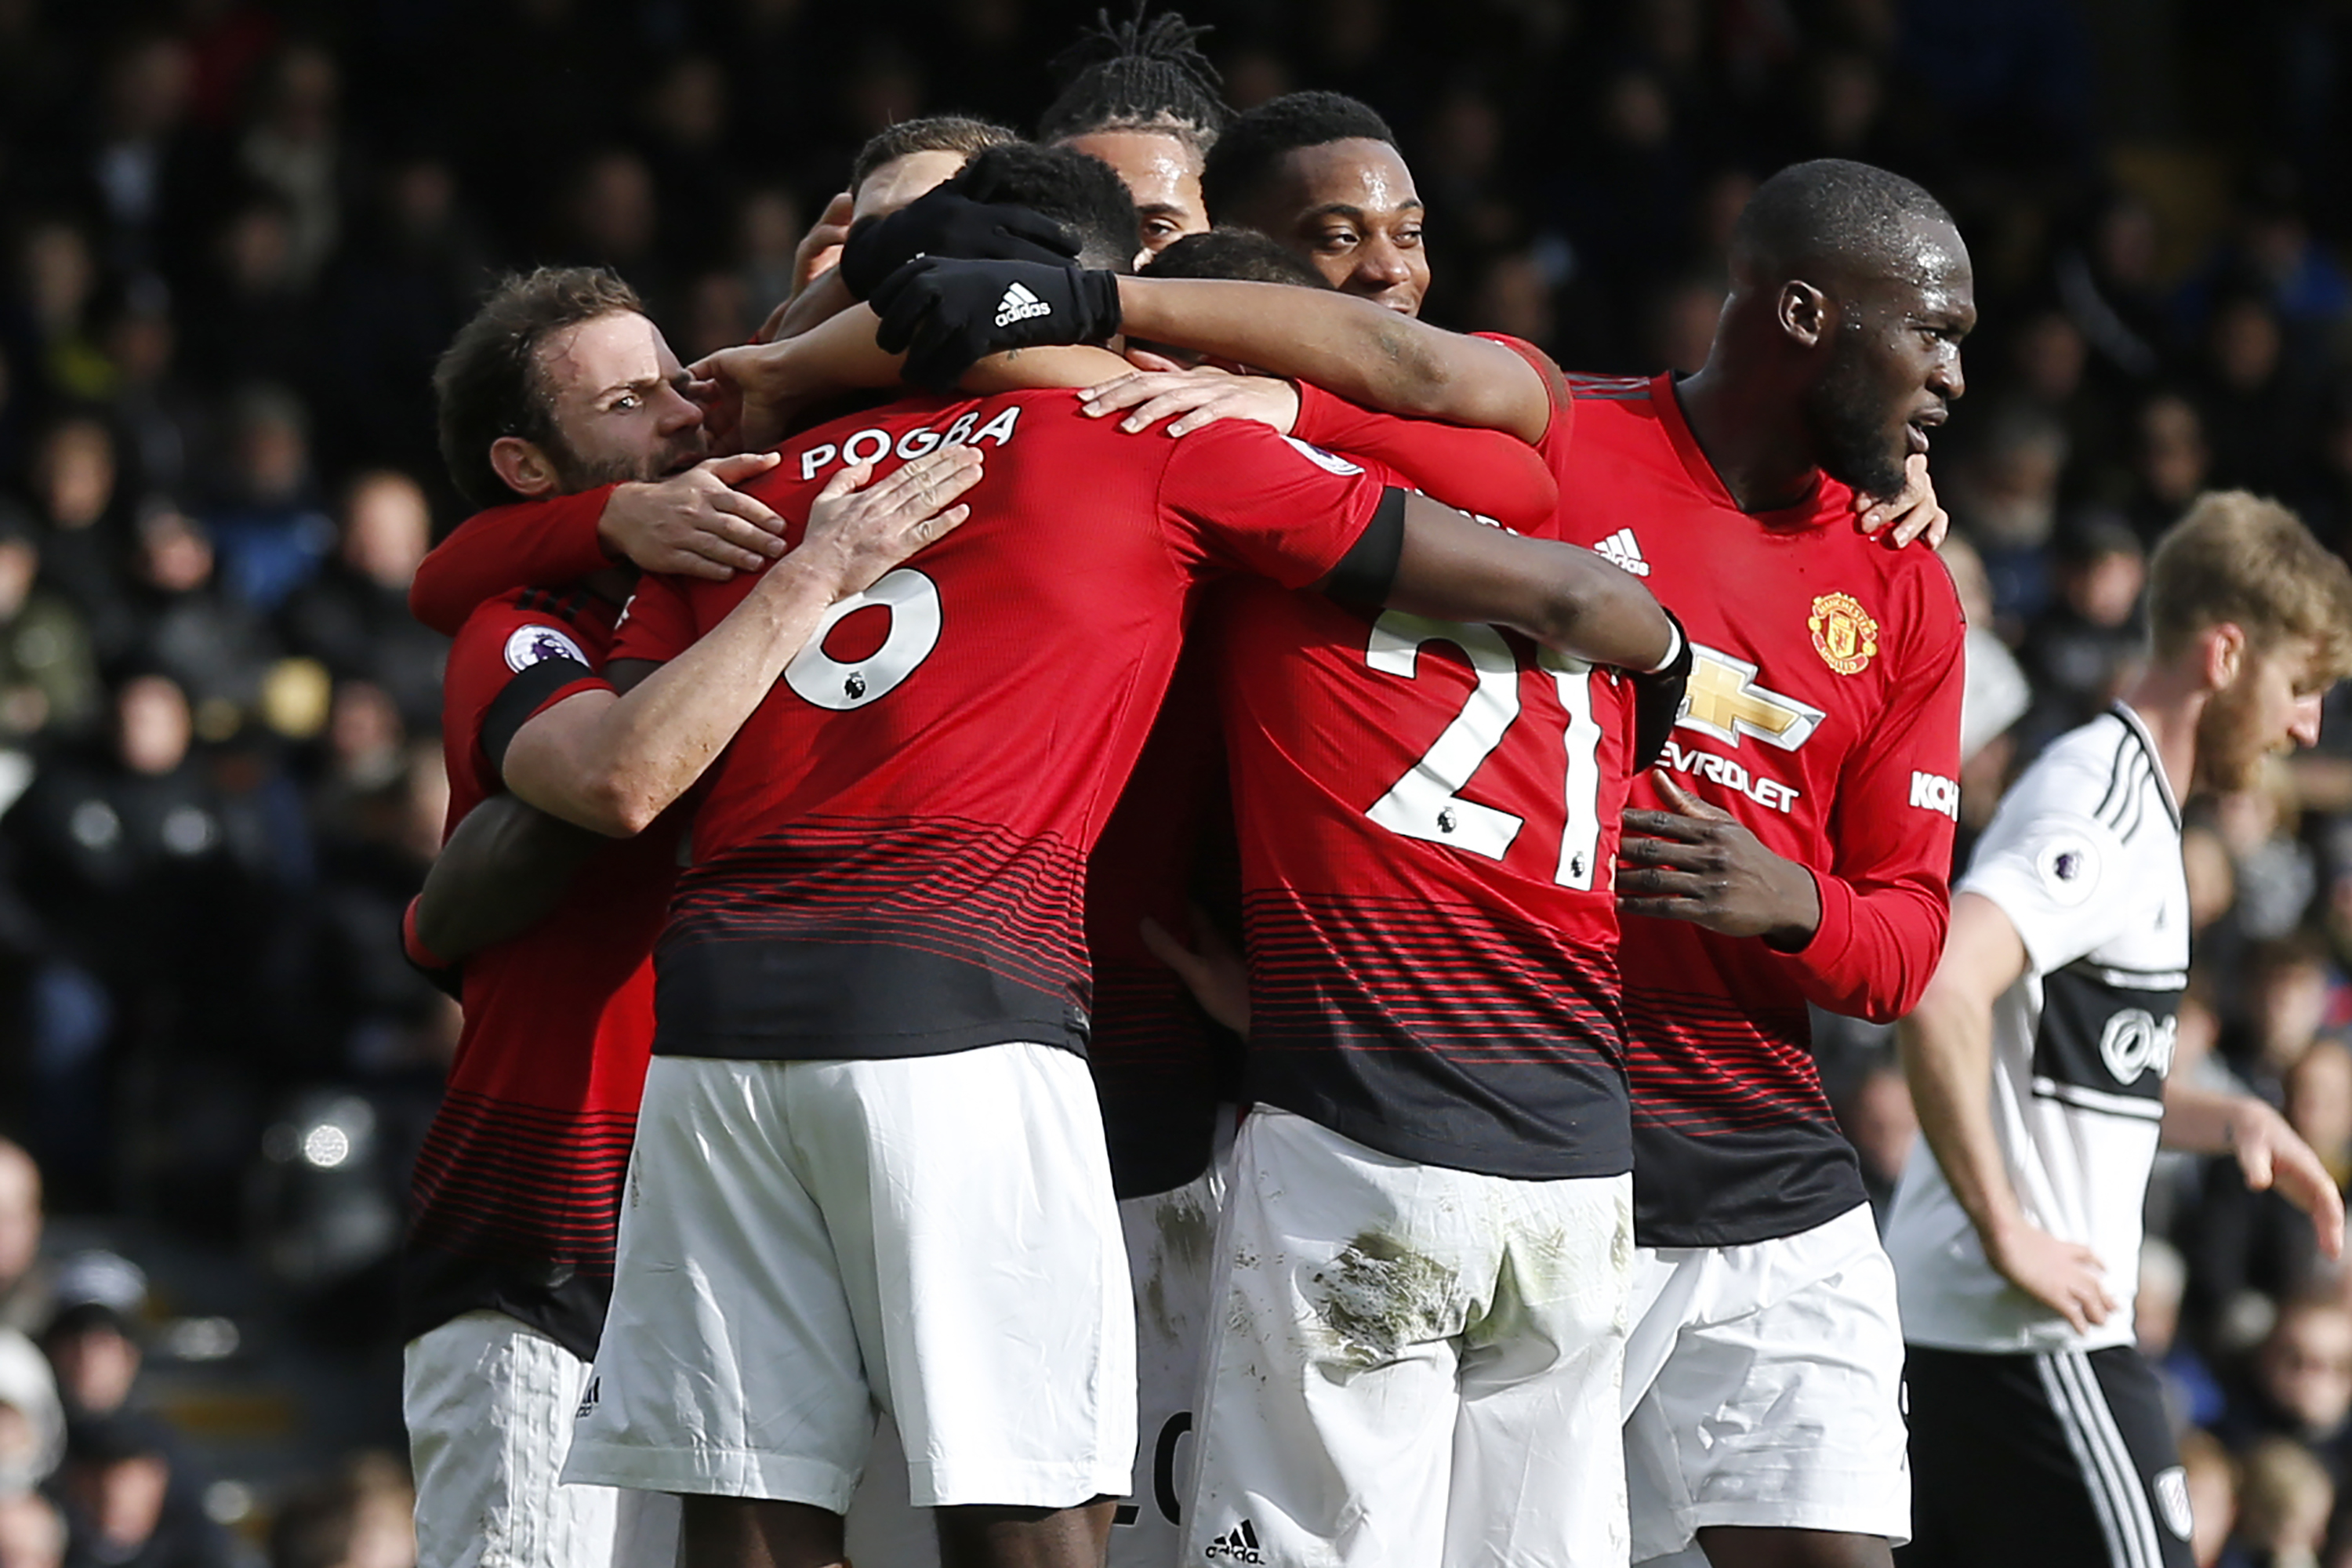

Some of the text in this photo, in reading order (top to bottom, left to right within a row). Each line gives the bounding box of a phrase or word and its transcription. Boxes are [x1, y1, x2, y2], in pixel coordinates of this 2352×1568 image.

[995, 302, 1051, 327] adidas
[801, 406, 1020, 481] POGBA
[1365, 608, 1601, 891] 21
[1654, 740, 1800, 814] EVROLET
